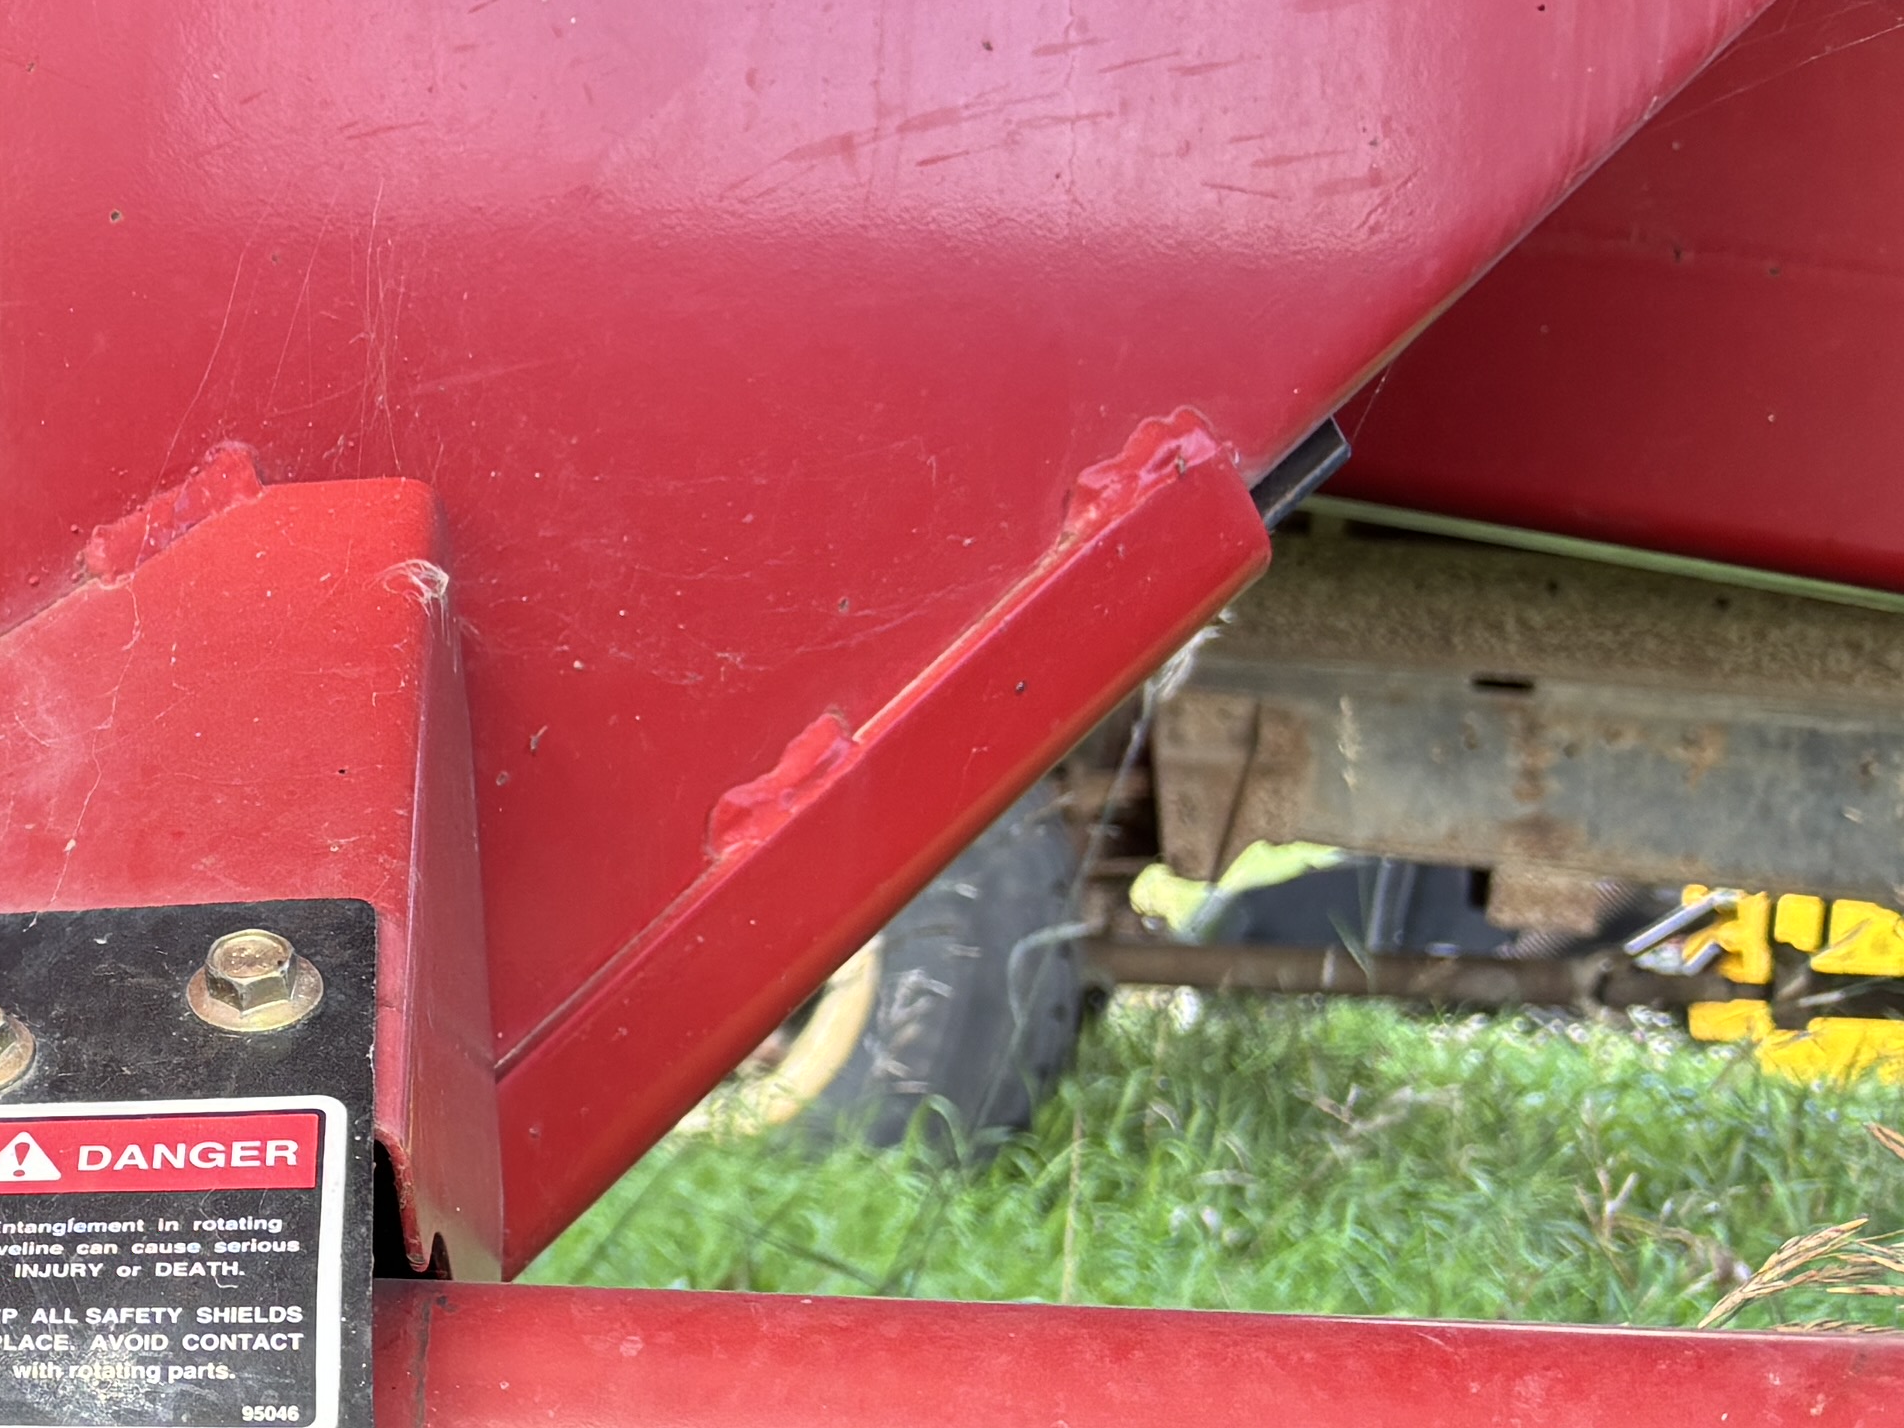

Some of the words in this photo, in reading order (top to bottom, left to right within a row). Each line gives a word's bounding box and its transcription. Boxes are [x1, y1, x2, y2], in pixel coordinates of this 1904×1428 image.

[77, 1139, 299, 1172] DANGER
[158, 1217, 180, 1232] in
[193, 1215, 283, 1233] rotating
[76, 1243, 118, 1254] can
[131, 1242, 201, 1254] cause
[214, 1239, 300, 1253] serious
[14, 1262, 104, 1278] INJURY
[116, 1265, 142, 1277] or
[155, 1261, 246, 1277] DEATH.
[31, 1308, 79, 1324] ALL
[85, 1307, 183, 1324] SAFETY
[196, 1306, 304, 1323] SHIELDS
[90, 1333, 169, 1351] AVOID
[182, 1333, 305, 1351] CONTACT
[13, 1363, 61, 1380] with
[68, 1363, 161, 1383] rotating
[169, 1363, 237, 1382] parts.
[241, 1405, 300, 1422] 95046
